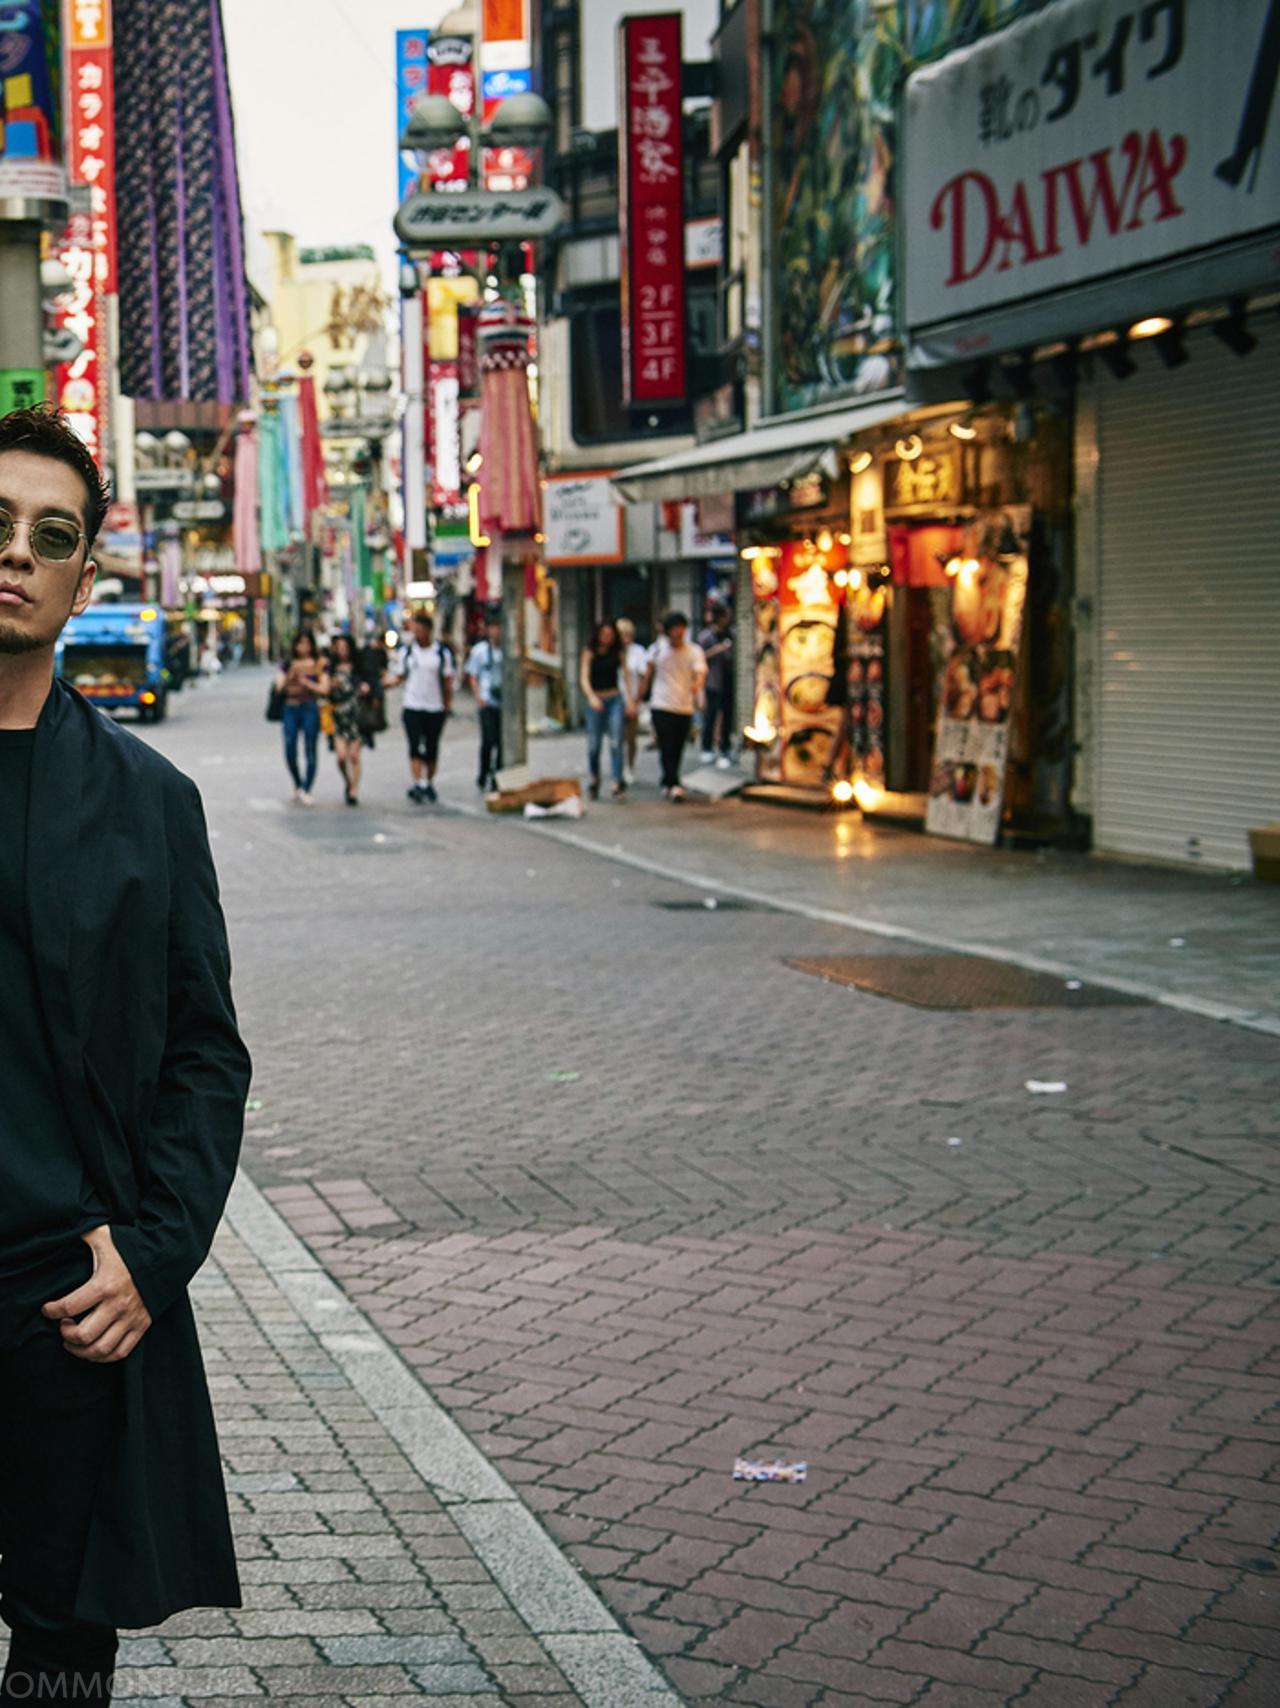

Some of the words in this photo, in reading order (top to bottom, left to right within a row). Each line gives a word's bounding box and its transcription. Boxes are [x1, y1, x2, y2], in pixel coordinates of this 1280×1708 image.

[930, 128, 1188, 288] DAIWA
[640, 284, 674, 310] 2F
[641, 320, 674, 346] 3F
[641, 357, 675, 381] 4F
